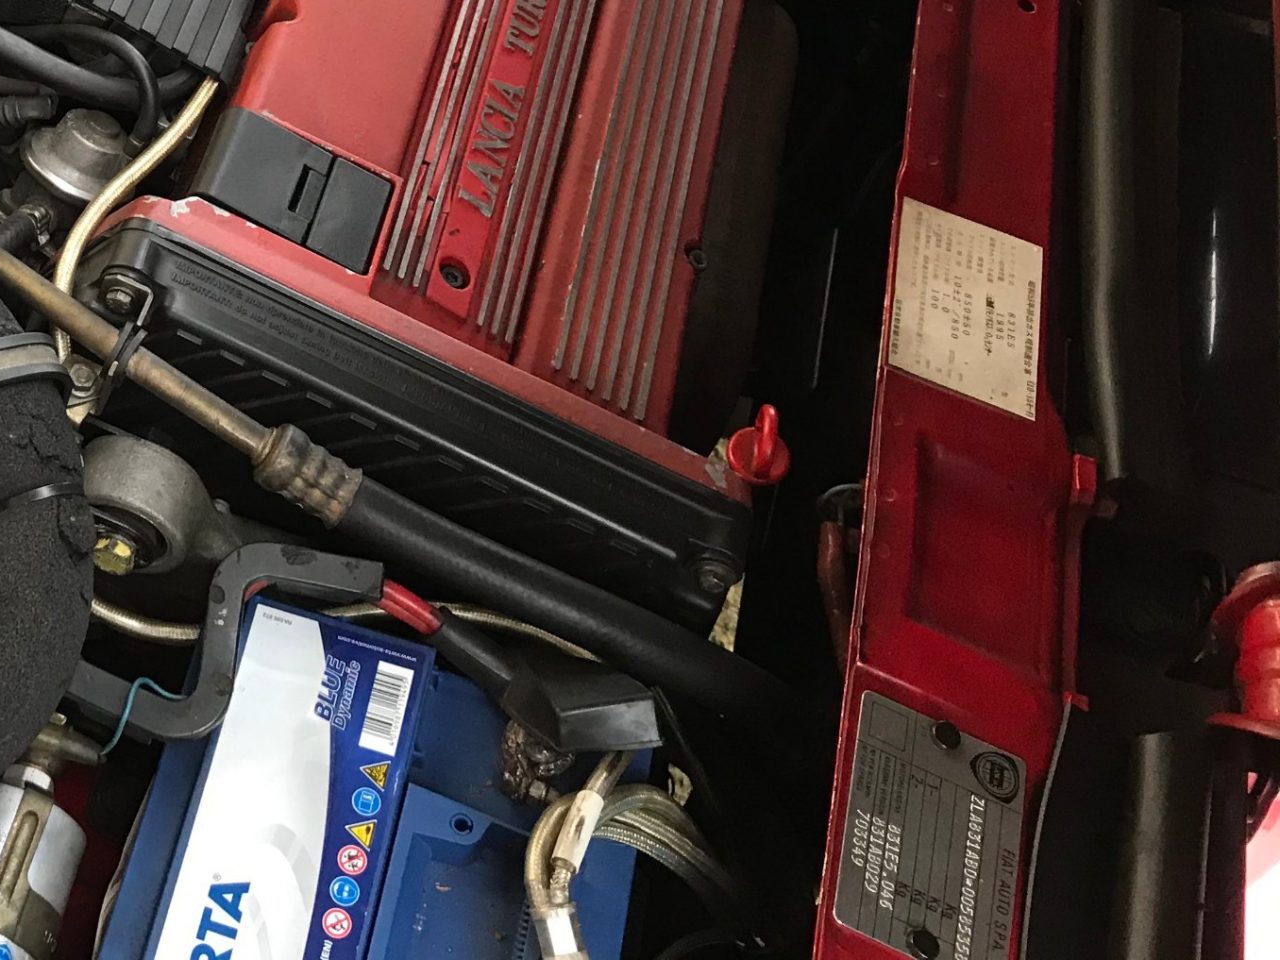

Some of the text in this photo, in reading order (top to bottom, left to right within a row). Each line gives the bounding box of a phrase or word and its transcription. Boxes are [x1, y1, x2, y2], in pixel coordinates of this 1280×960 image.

[458, 79, 525, 219] LANCIA
[995, 312, 1005, 340] 1995
[1007, 312, 1017, 349] 831E5
[314, 654, 346, 722] BLUE
[332, 660, 361, 731] Dynamic
[850, 809, 871, 867] 703349
[1001, 848, 1016, 877] FIAT
[894, 881, 911, 898] Kg
[910, 889, 927, 906] Kg
[926, 895, 942, 913] Kg
[996, 882, 1013, 914] AUTO
[941, 903, 959, 921] Kg
